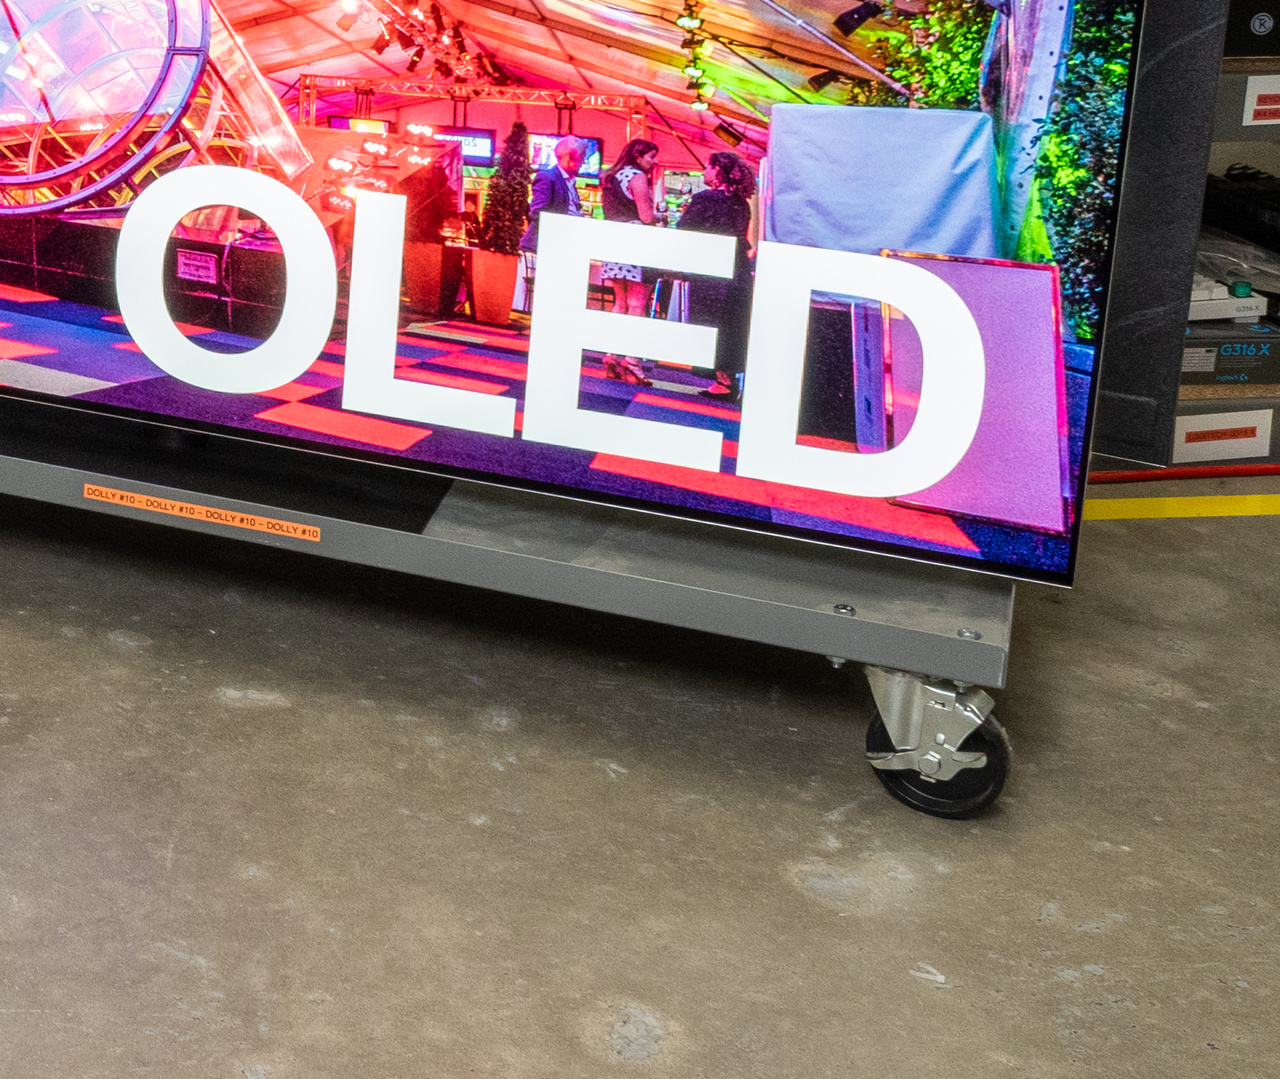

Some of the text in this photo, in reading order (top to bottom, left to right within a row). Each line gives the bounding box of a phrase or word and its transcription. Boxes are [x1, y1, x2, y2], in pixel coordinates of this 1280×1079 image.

[116, 165, 985, 497] OLED
[1220, 344, 1270, 356] G316 X
[86, 487, 117, 500] DOLLY
[119, 494, 135, 504] #10
[145, 498, 176, 512] DOLLY
[179, 506, 195, 515] #10
[205, 510, 237, 523] DOLLY
[239, 517, 256, 527] #10
[266, 521, 299, 535] DOLLY
[301, 528, 318, 538] #10
